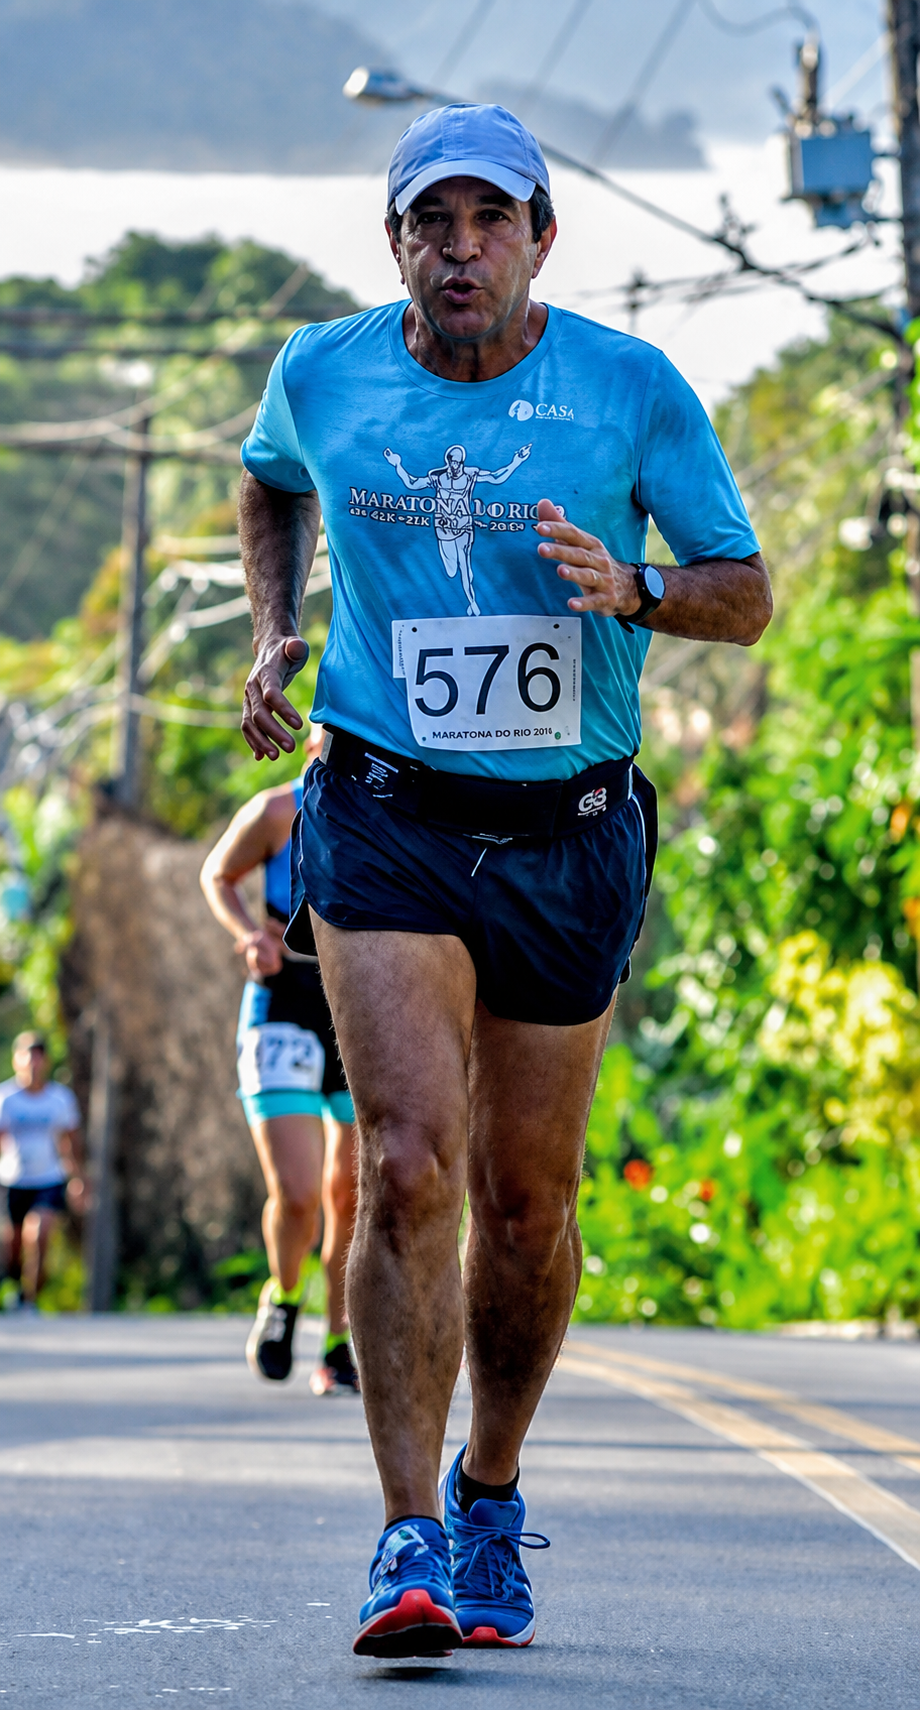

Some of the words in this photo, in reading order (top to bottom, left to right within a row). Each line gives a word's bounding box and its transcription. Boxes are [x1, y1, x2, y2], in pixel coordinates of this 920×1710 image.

[349, 487, 467, 514] MARATONA
[414, 642, 562, 718] 576
[432, 730, 492, 740] MARATONA
[495, 730, 512, 739] DO
[513, 728, 532, 738] RIO
